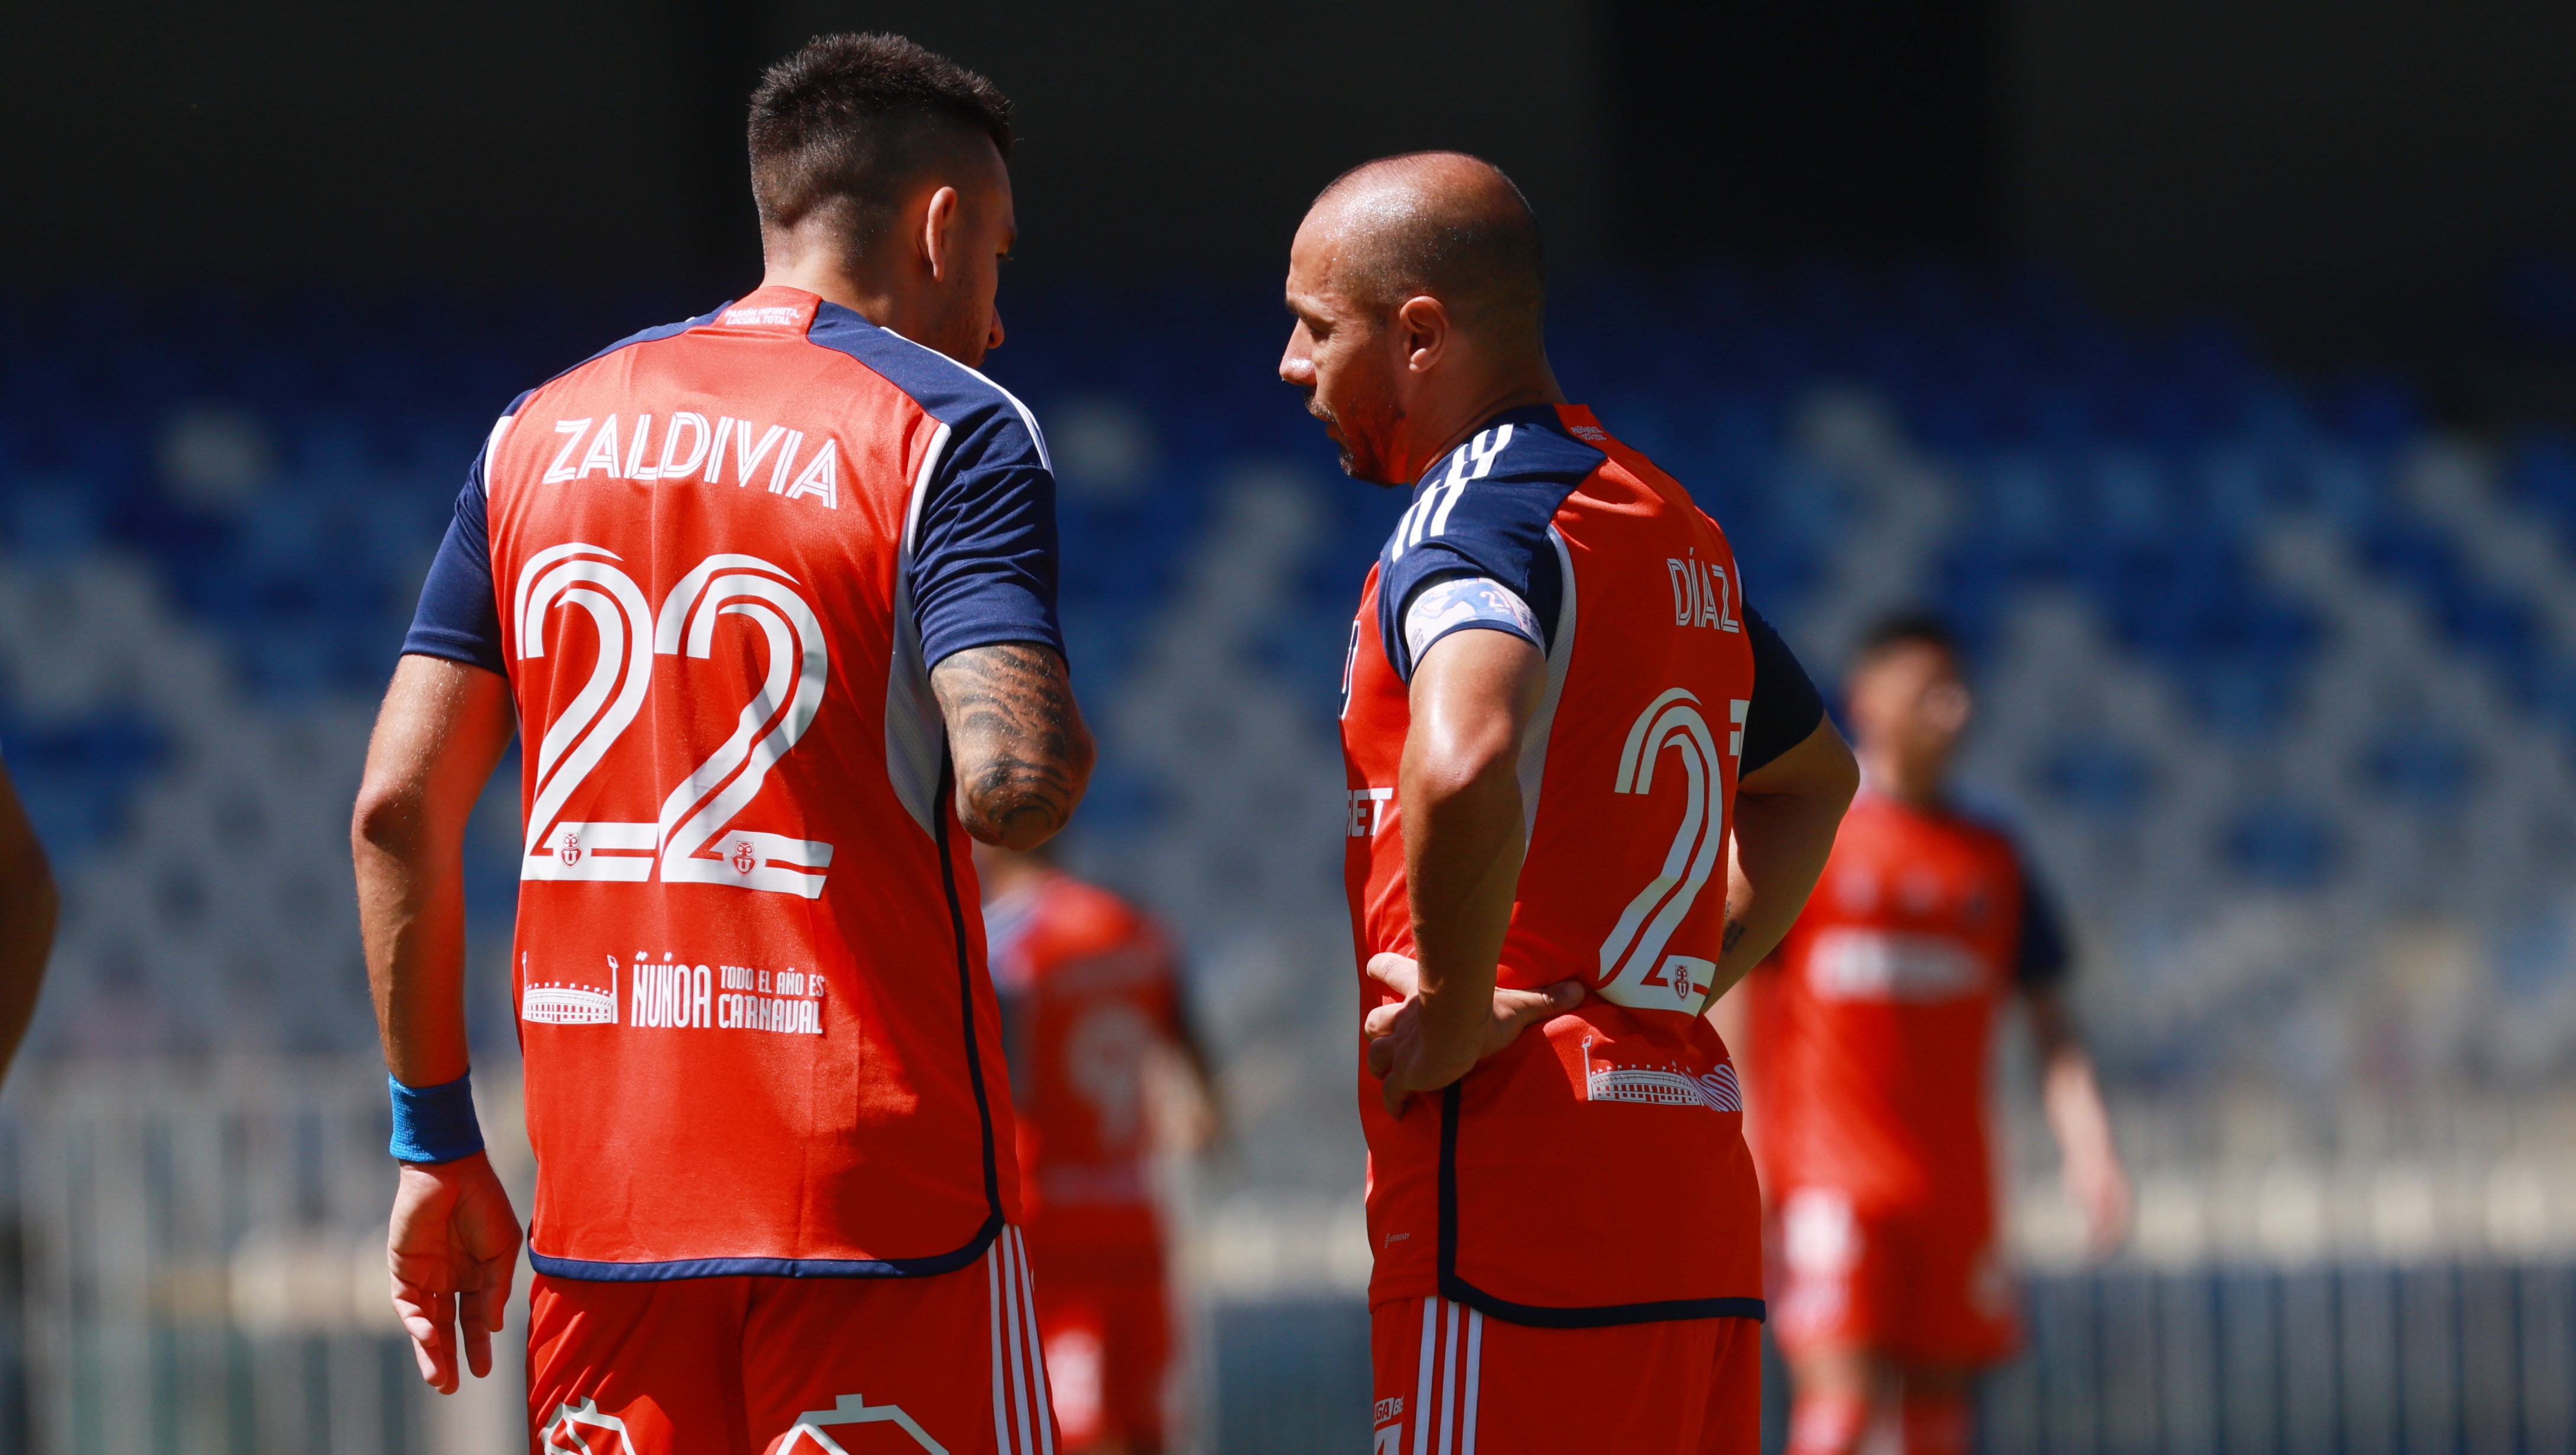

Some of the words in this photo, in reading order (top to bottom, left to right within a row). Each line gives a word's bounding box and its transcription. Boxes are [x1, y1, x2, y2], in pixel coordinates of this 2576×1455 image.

[724, 308, 757, 318] PASIÓN
[725, 316, 761, 324] LOCURA
[763, 316, 791, 325] TOTAL
[543, 411, 836, 509] ZALDIVIA
[1666, 547, 1739, 633] DÍAZ
[514, 543, 833, 898] 22
[631, 951, 712, 1028] ÑUÑOA
[720, 966, 754, 990] TODO
[758, 970, 772, 993] EL
[776, 967, 804, 995] AÑO
[809, 974, 825, 997] ES
[718, 993, 823, 1034] CARNAVAL
